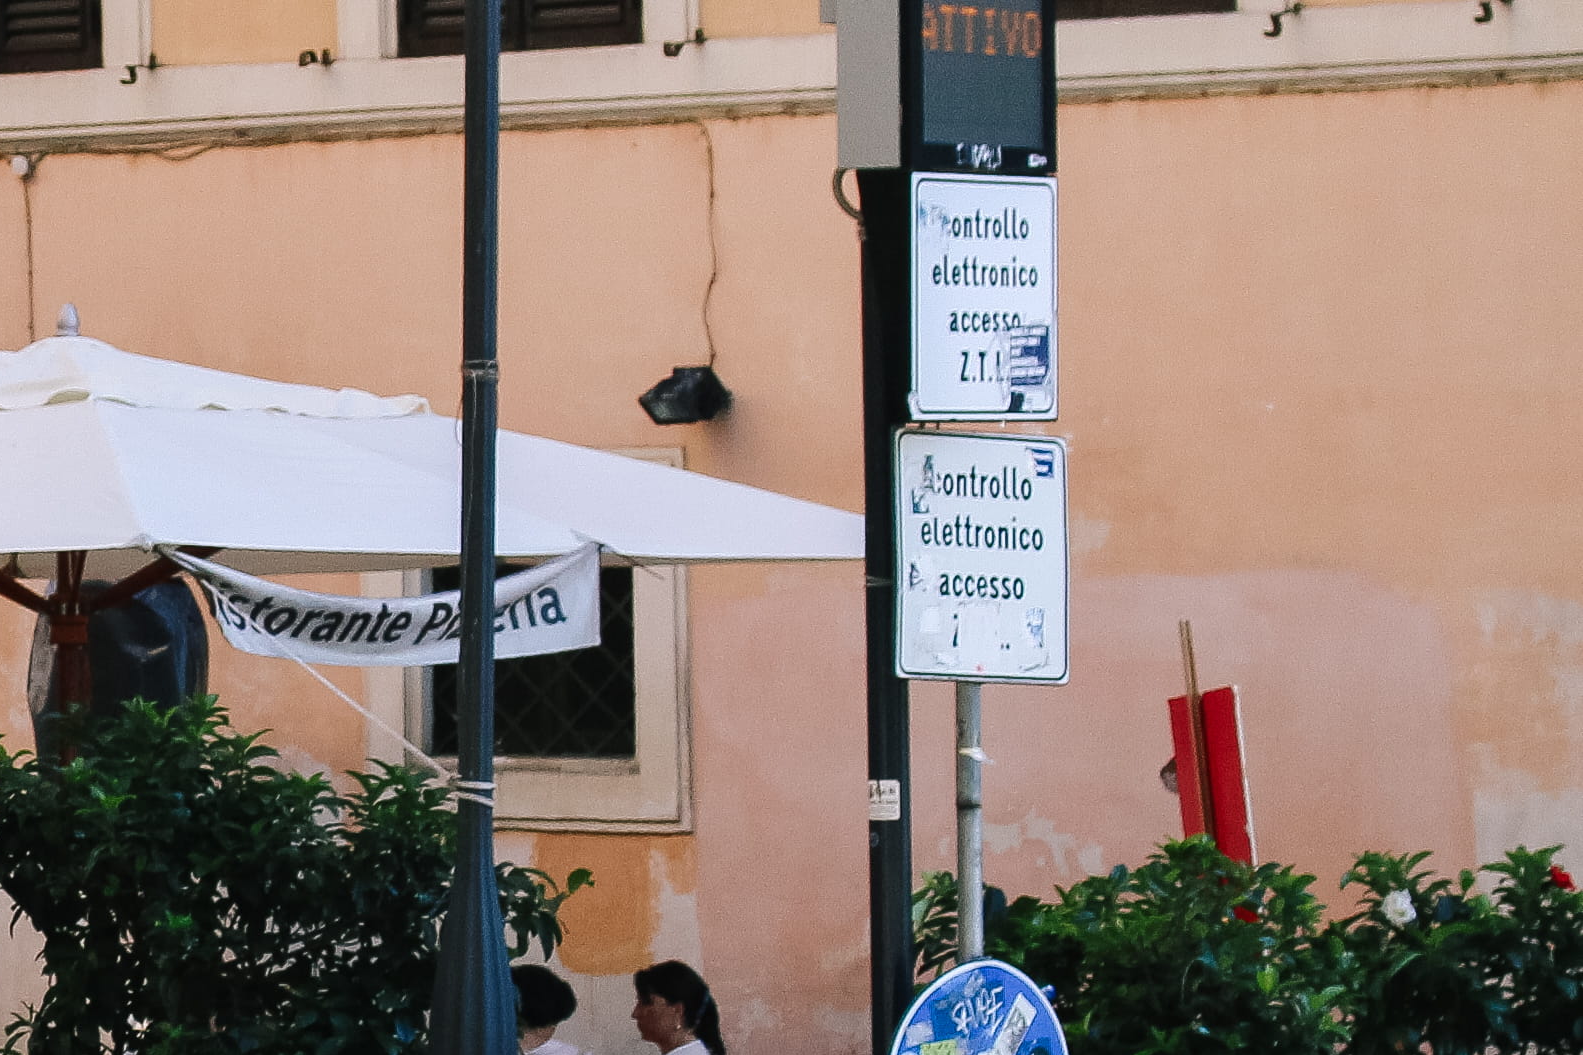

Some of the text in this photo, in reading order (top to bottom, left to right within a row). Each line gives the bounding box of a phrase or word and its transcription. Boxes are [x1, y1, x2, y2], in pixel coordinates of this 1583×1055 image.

[921, 2, 1043, 59] ATTIVO
[947, 206, 1030, 240] ontrollo
[932, 253, 1039, 288] elettronico
[949, 309, 1021, 333] accesso
[920, 514, 1045, 551] elettronico
[939, 571, 1025, 601] accesso
